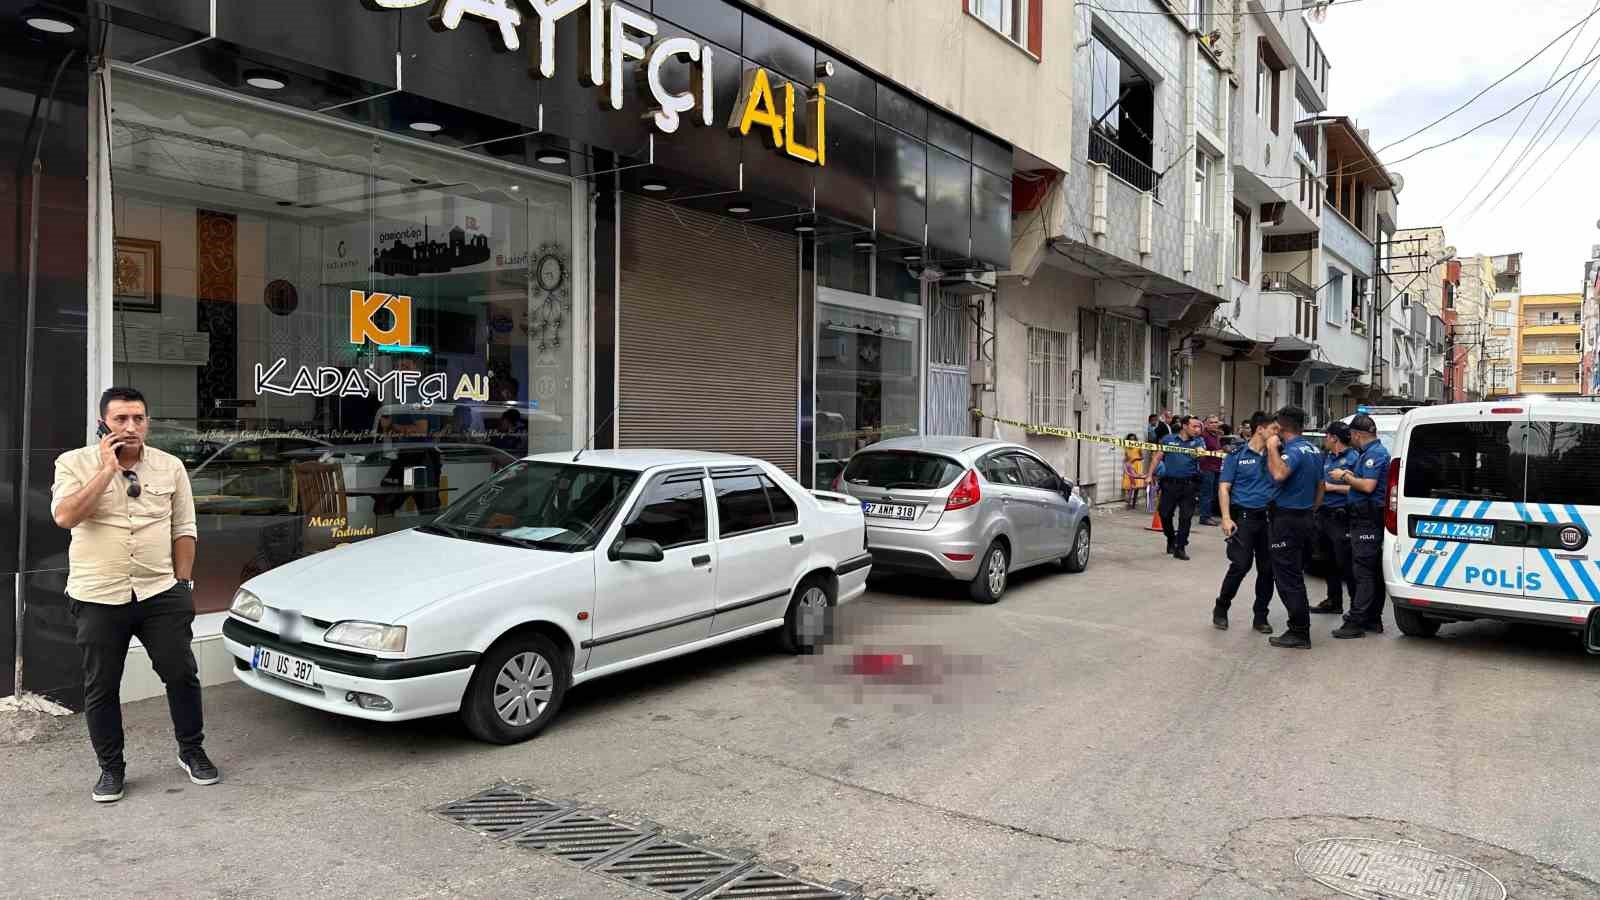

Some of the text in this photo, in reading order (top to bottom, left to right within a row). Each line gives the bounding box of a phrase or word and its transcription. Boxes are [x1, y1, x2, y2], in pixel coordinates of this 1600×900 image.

[372, 0, 714, 133] YIFÇI
[254, 357, 448, 407] KADAYIFÇI
[865, 503, 877, 513] 27
[896, 505, 914, 517] 318
[308, 515, 347, 529] Maraş
[1422, 522, 1438, 534] 27
[1440, 523, 1449, 536] A
[1452, 523, 1491, 538] 72433
[1564, 531, 1577, 543] FIAT
[1465, 565, 1542, 591] POLİS
[260, 650, 313, 681] 10 US 387
